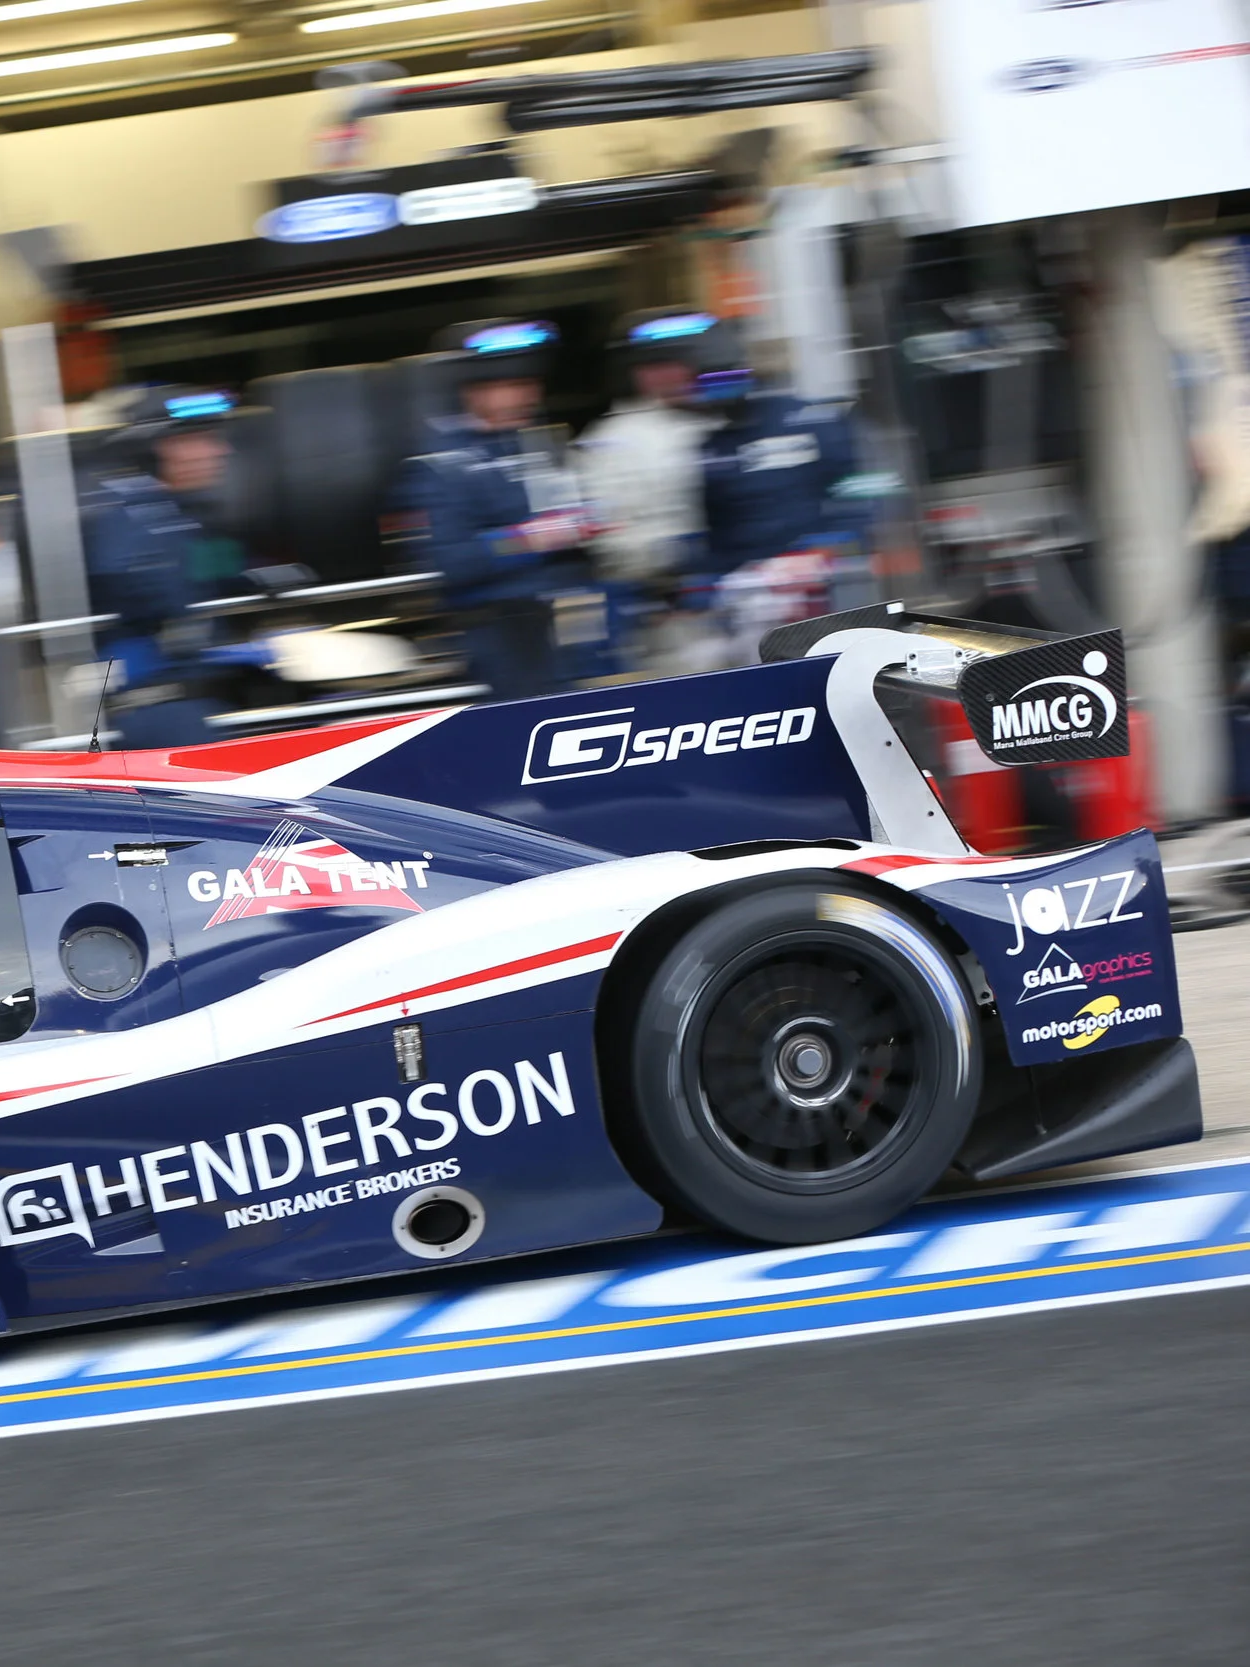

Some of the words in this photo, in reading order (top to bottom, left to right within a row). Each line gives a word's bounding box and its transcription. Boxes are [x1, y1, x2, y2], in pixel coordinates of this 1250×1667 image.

[623, 706, 816, 767] SPEED
[992, 693, 1093, 741] MMCG
[1071, 730, 1093, 739] Group
[187, 865, 312, 902] GALA
[318, 860, 430, 893] TENT
[1002, 870, 1143, 955] jazz
[1023, 962, 1084, 989] GALA
[1082, 952, 1153, 982] graphics
[1022, 1003, 1162, 1043] motorsport.com
[84, 1051, 577, 1217] HENDERSON
[225, 1185, 352, 1230] INSURANCE
[356, 1158, 463, 1200] BROKERS
